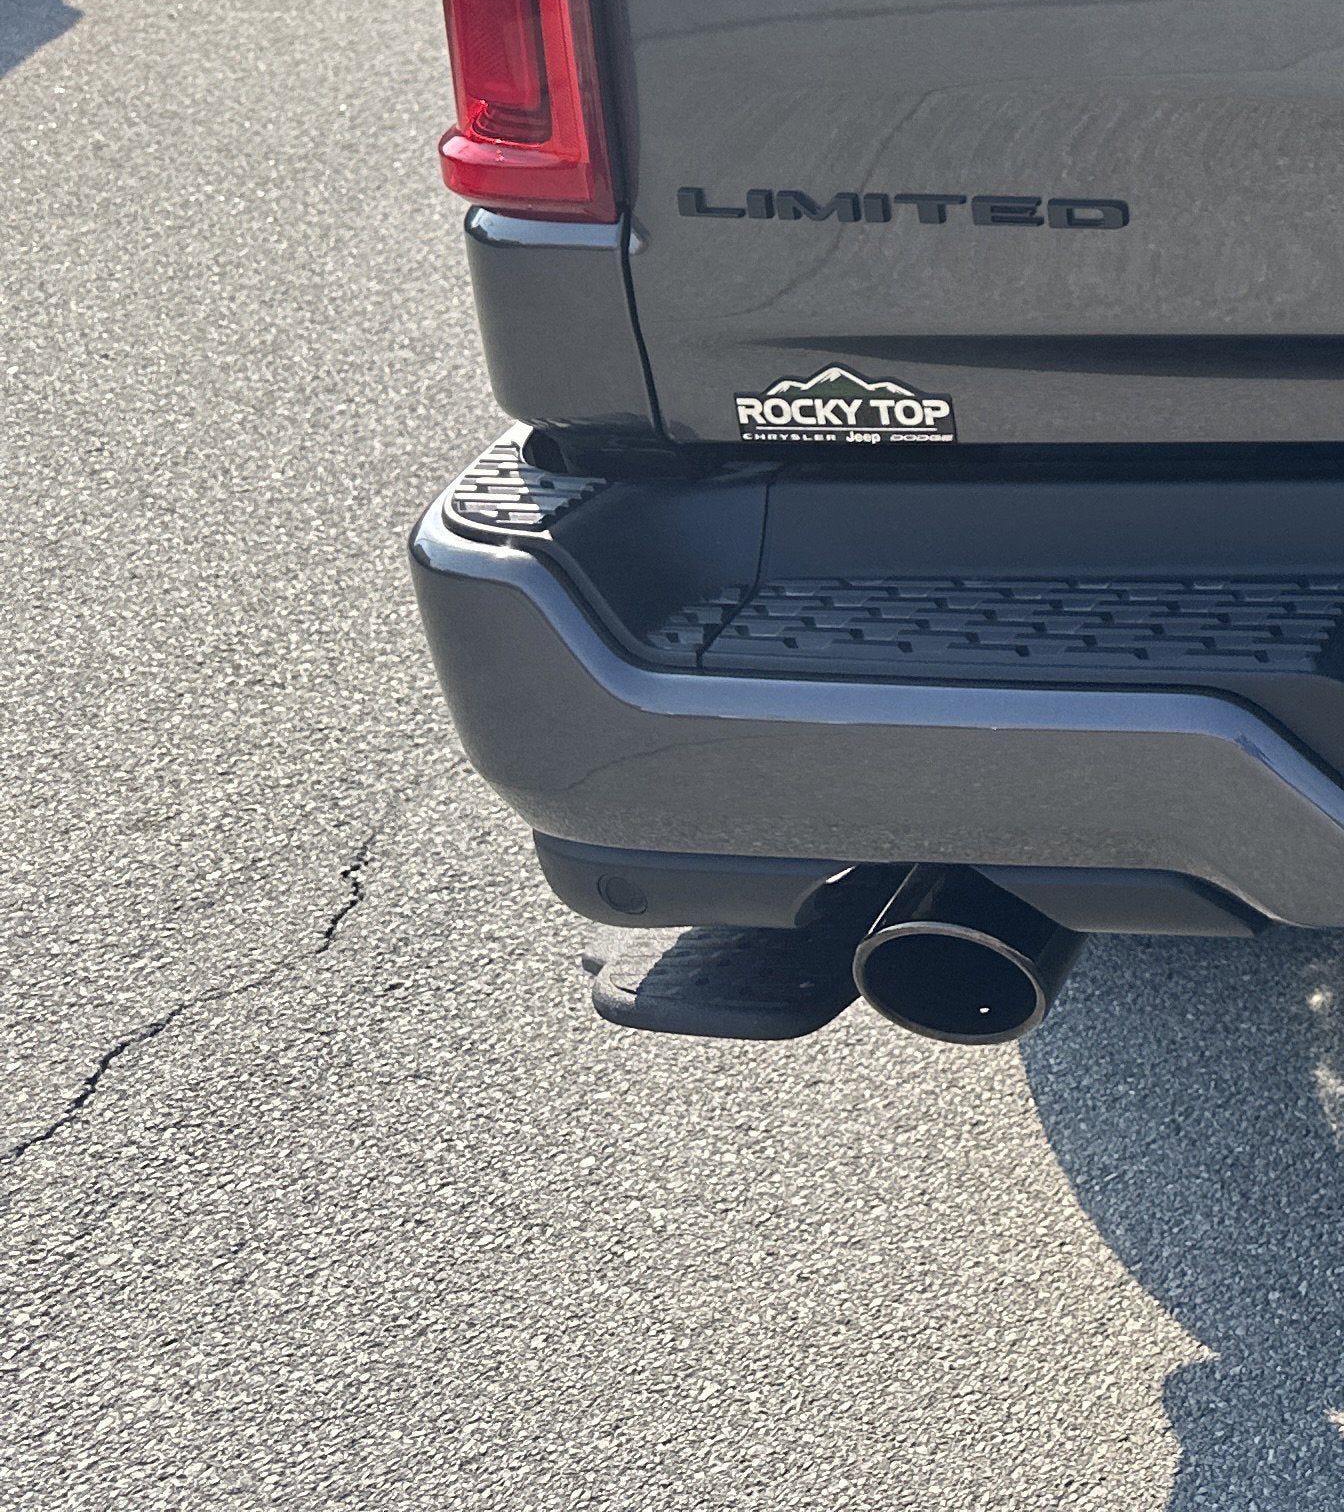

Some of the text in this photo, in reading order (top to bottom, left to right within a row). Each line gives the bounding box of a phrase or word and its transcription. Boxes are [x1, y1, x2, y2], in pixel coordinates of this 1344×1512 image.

[677, 186, 1130, 229] LIMITED
[736, 397, 951, 426] ROCKY TOP
[742, 431, 954, 444] CHRYSLER Jeep DODGE
